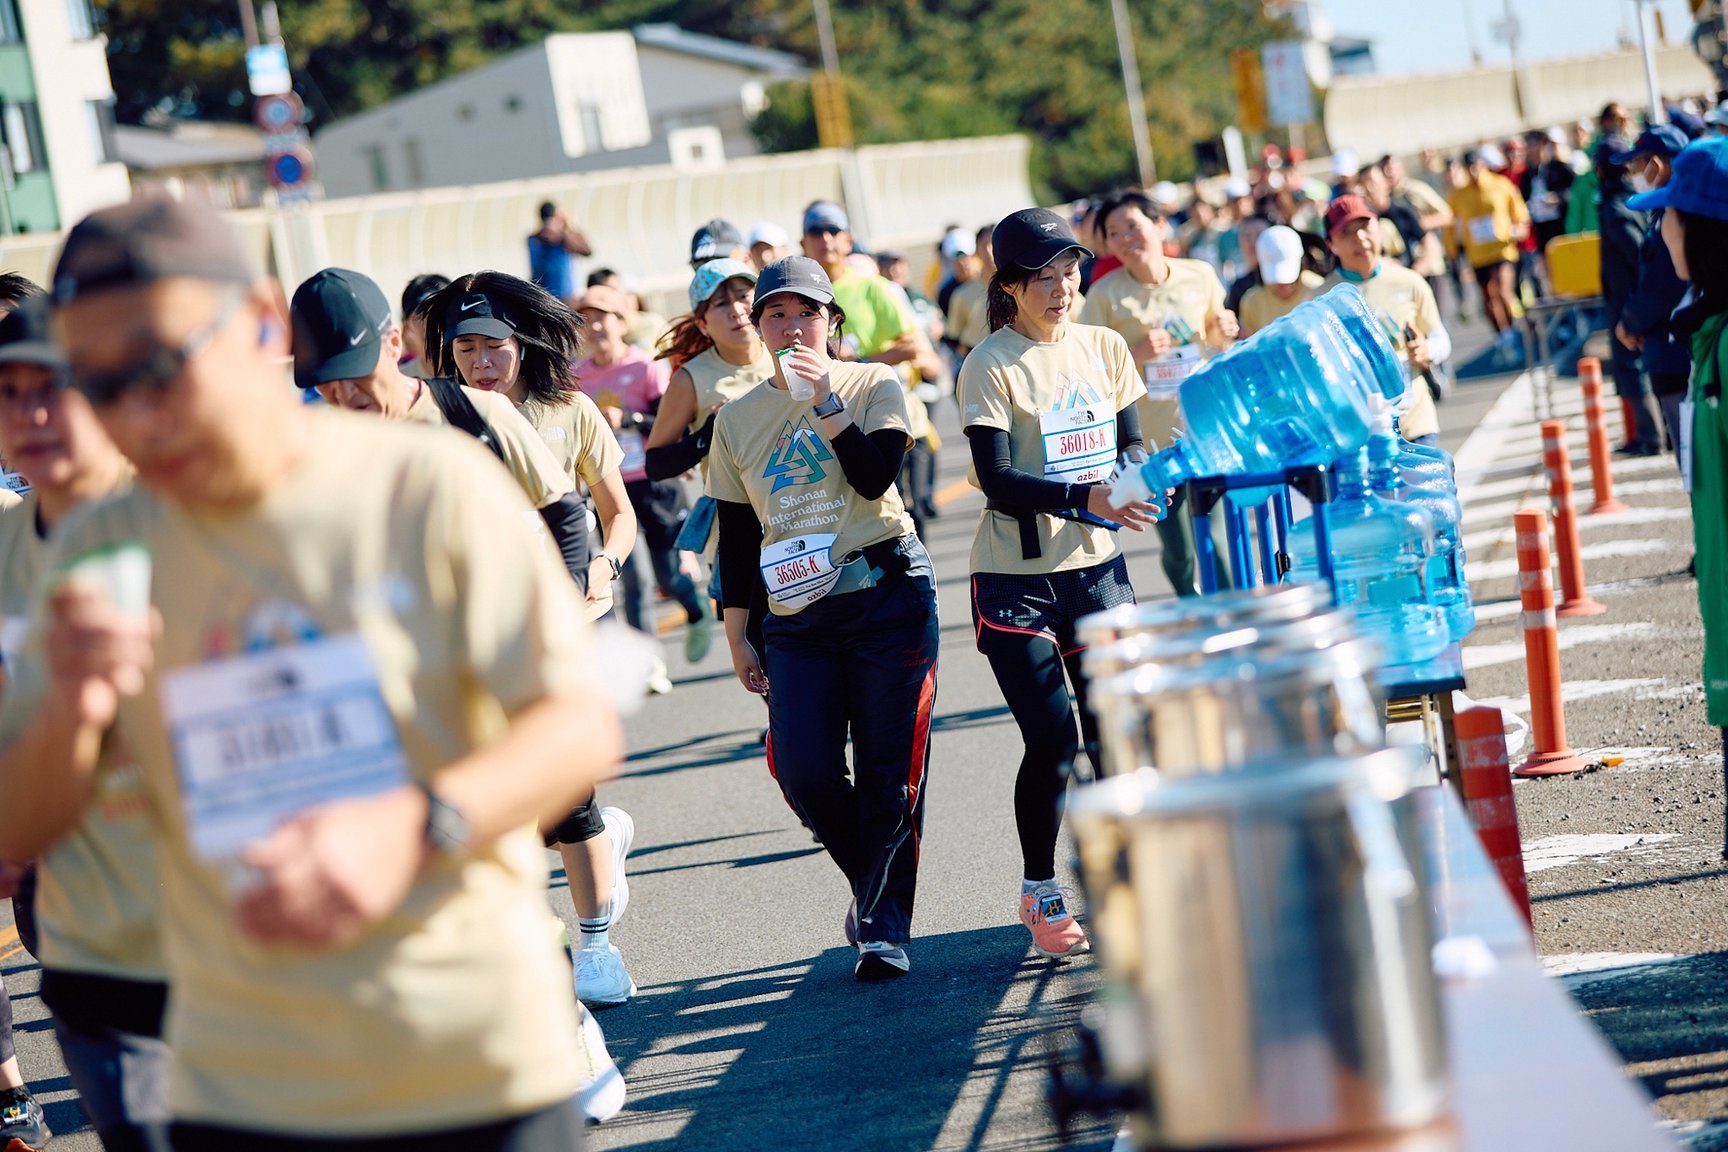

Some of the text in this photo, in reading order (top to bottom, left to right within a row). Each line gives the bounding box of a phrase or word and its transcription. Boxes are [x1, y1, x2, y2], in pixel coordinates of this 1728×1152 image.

[1060, 428, 1106, 455] 36018-K
[1077, 469, 1099, 481] azbil
[779, 489, 827, 509] Shonan
[766, 494, 846, 526] International
[780, 513, 840, 533] Marathon
[775, 555, 820, 584] 36505-K
[807, 588, 827, 601] azbil
